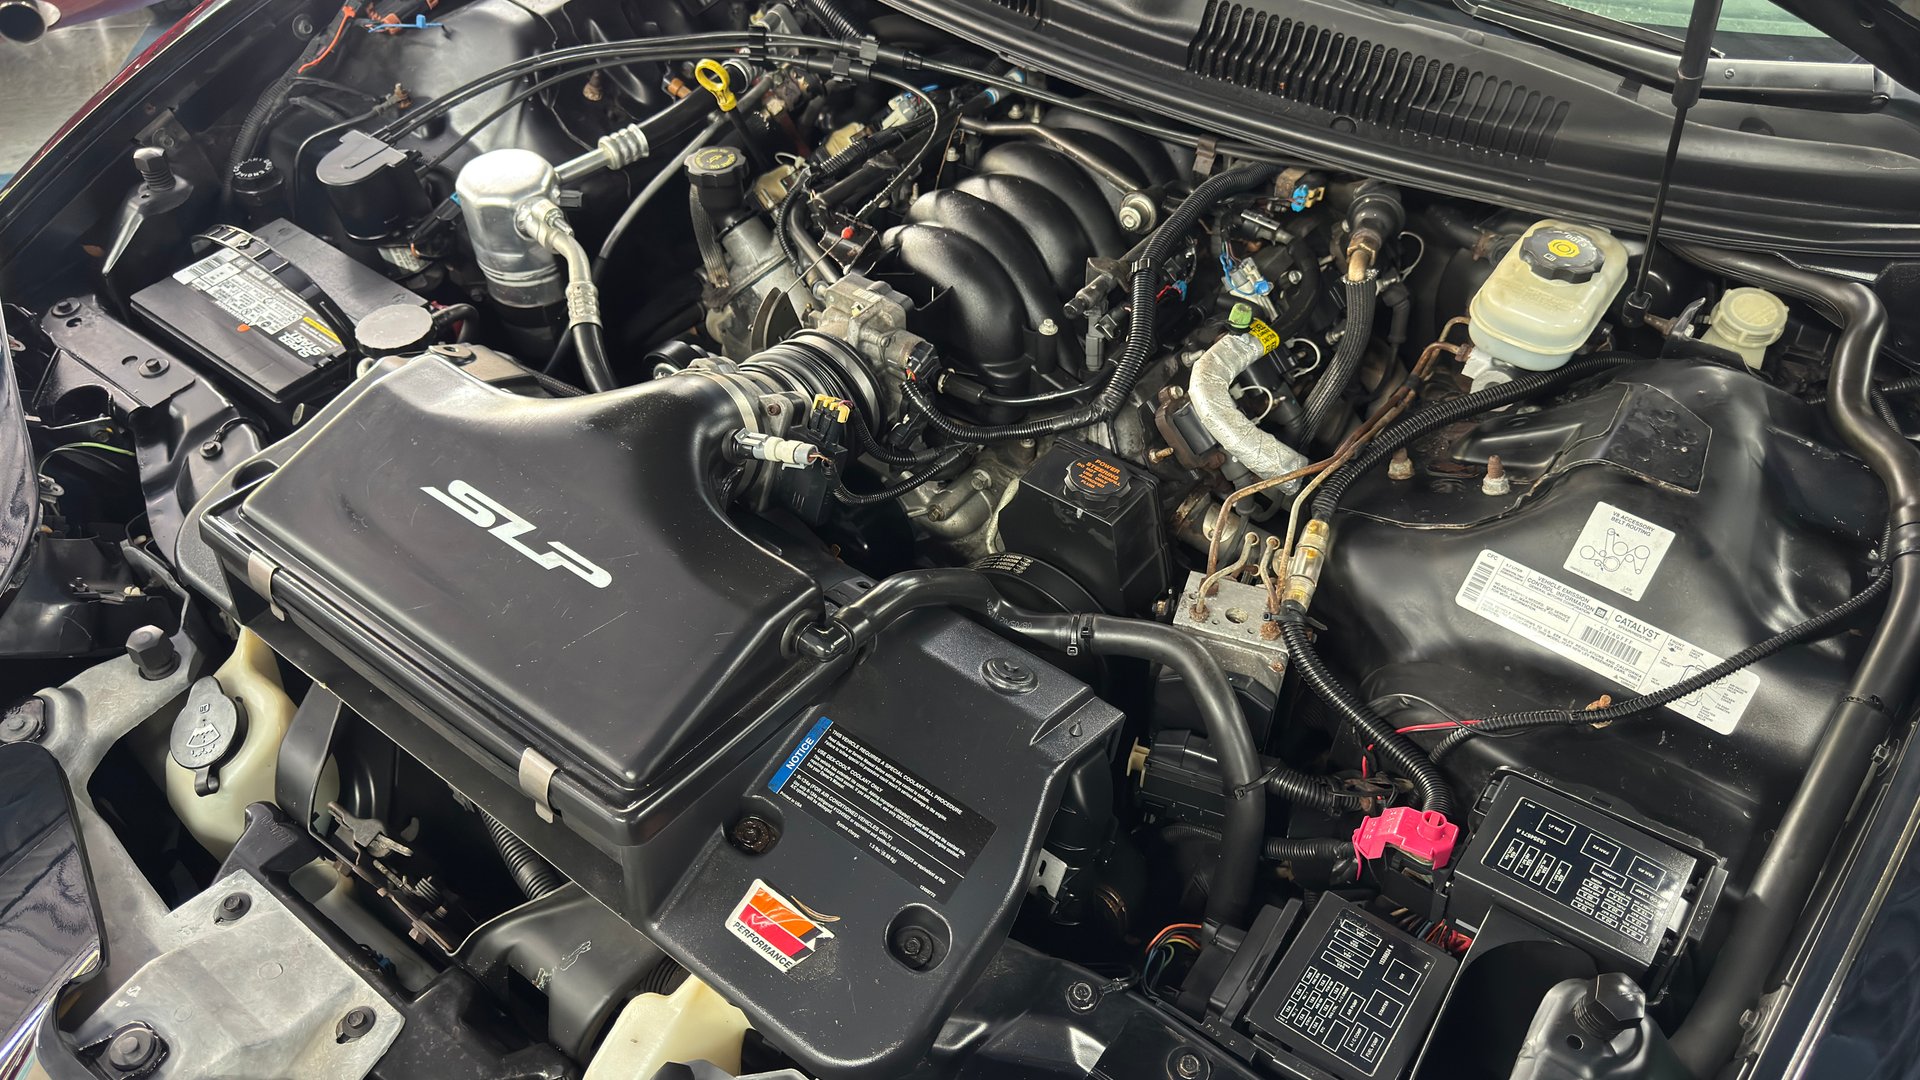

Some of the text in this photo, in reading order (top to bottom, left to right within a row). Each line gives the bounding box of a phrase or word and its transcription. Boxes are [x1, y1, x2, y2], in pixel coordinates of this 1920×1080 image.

[278, 334, 310, 358] SUPER
[284, 329, 327, 357] START
[1086, 461, 1119, 481] STEERING
[1094, 459, 1121, 474] POWER
[1078, 474, 1105, 489] APPROVED
[1080, 479, 1096, 489] FLUID
[1082, 470, 1109, 485] USE ONLY
[1086, 466, 1097, 474] NOT
[1097, 473, 1121, 487] OVERFILL
[1610, 516, 1651, 536] BELT ROUTING
[1620, 514, 1655, 532] ACCESSORY
[419, 479, 613, 589] SLP
[1486, 552, 1498, 561] CFC
[1526, 577, 1595, 612] CONTROL INFORMATION
[1528, 583, 1546, 594] GENERAL
[1537, 576, 1589, 603] VEHICLE EMISSION
[1613, 613, 1660, 640] CATALYST
[785, 736, 814, 770] NOTICE
[816, 747, 827, 757] USE
[849, 768, 871, 785] COOLANT
[869, 782, 883, 793] ONLY
[831, 729, 843, 738] THIS
[840, 735, 860, 749] VEHICLE
[858, 746, 881, 763] REQUIRES
[883, 762, 904, 777] SPECIAL
[902, 774, 925, 791] COOLANT
[923, 787, 935, 797] FILL
[933, 794, 963, 815] PROCEDURE
[809, 782, 822, 793] (FOR
[819, 790, 830, 799] AIR
[827, 795, 859, 818] CONDITIONED
[856, 814, 880, 832] VEHICLES
[877, 828, 893, 841] ONLY)
[1553, 825, 1564, 833] FAN
[1597, 846, 1610, 855] FAN
[1600, 869, 1617, 880] HORN
[1643, 869, 1656, 878] FAN
[1633, 887, 1650, 898] LAMP
[732, 921, 793, 969] PERFORMANCE
[1349, 998, 1358, 1009] PUMP
[1377, 999, 1389, 1016] STARTER
[1353, 1027, 1362, 1039] COMP
[1364, 1036, 1379, 1057] FUEL PUMP
